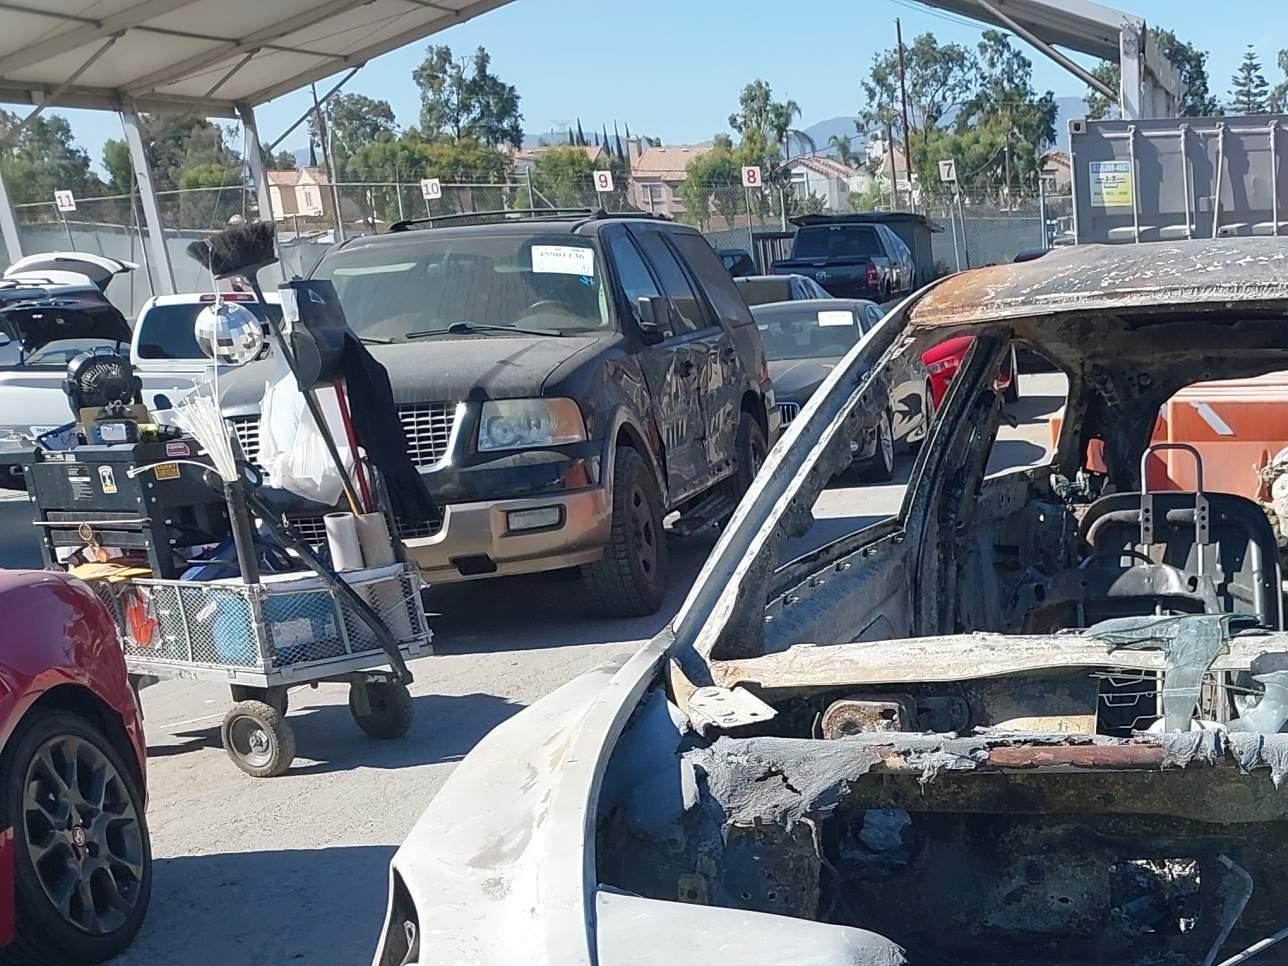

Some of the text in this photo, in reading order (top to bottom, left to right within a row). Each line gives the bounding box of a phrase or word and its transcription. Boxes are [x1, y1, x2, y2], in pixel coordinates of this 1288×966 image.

[746, 168, 757, 184] 8
[943, 162, 953, 178] 7
[598, 173, 609, 188] 9
[423, 182, 439, 195] 10
[57, 194, 74, 207] 11
